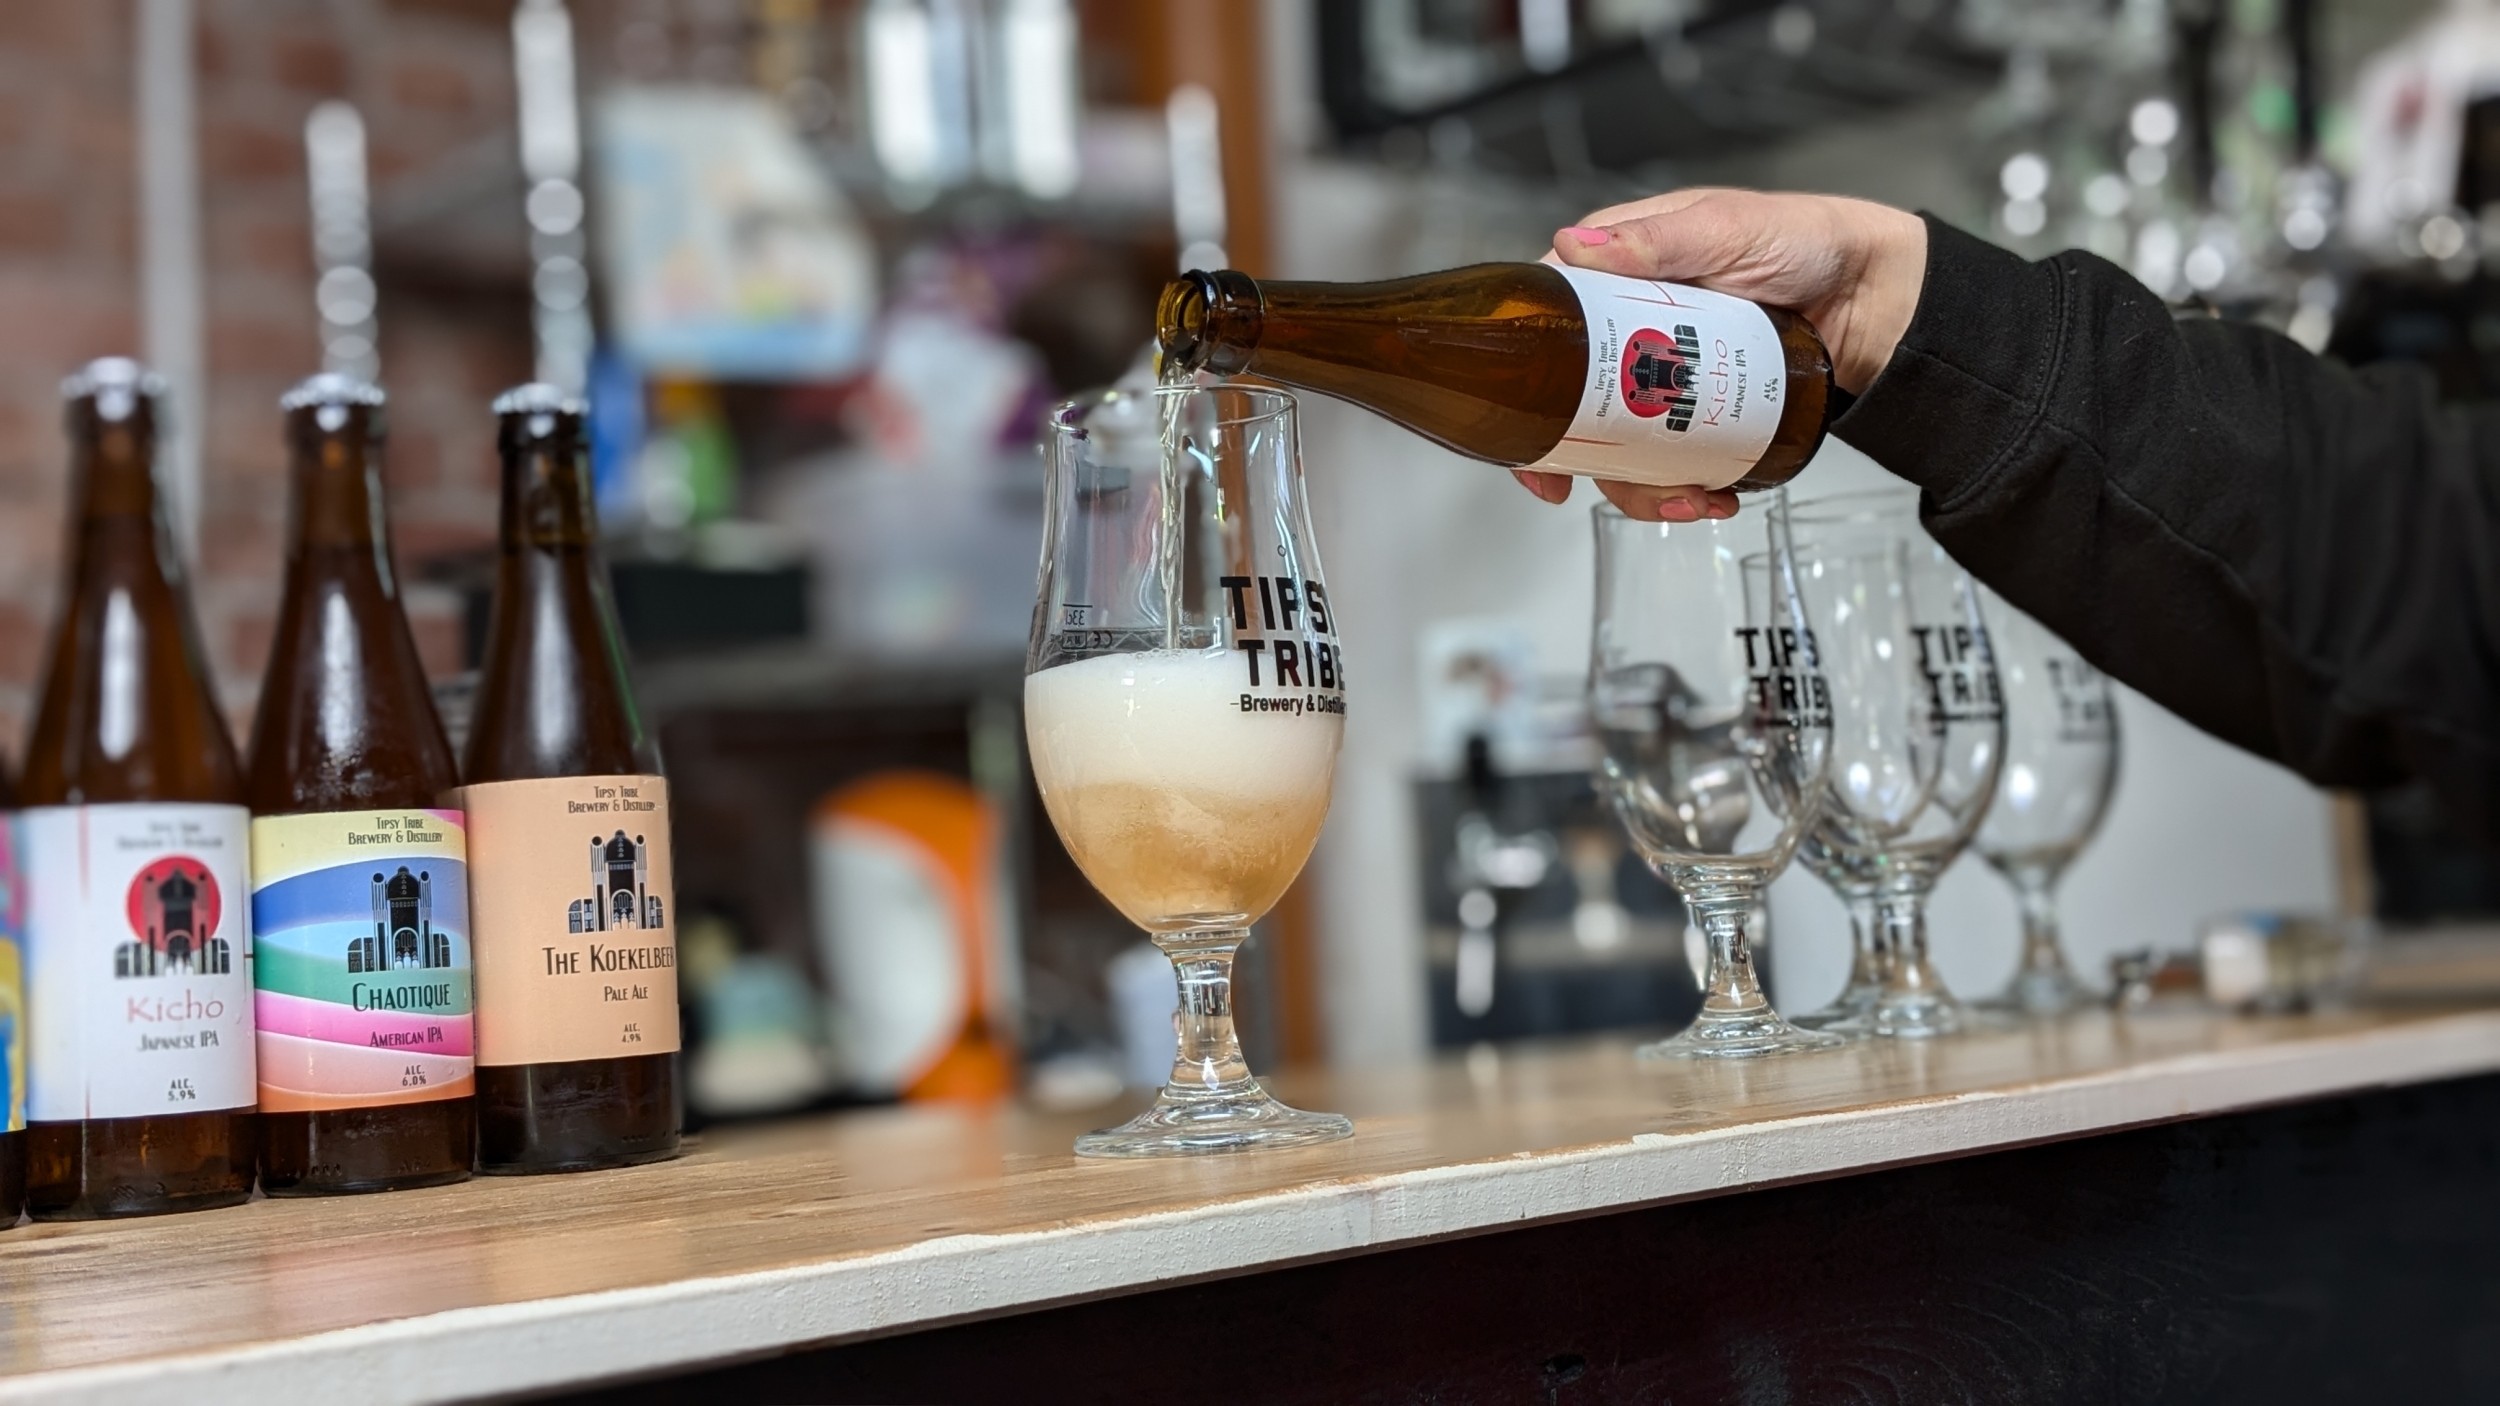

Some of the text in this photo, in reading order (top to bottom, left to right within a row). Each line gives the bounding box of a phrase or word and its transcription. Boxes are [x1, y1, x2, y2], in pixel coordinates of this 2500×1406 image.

[1596, 317, 1618, 418] BREWERY & DISTILLERY
[1595, 367, 1607, 391] TIPSY
[1703, 339, 1729, 426] Kicho
[1729, 349, 1747, 422] JAPANESE IPA
[1240, 694, 1304, 716] Brewery
[1306, 694, 1315, 711] &
[594, 785, 639, 798] TIPSY TRIBE
[568, 800, 609, 813] BREWERY
[613, 800, 620, 811] &
[376, 816, 424, 829] TIPSY TRIBE
[348, 830, 443, 845] BREWERY & DISTILLERY
[542, 947, 580, 976] THE
[352, 982, 451, 1012] CHAOTIQUE
[604, 984, 648, 1002] PALE ALE
[127, 988, 224, 1023] Kicho
[369, 1026, 443, 1048] AMERICAN IPA
[624, 1024, 640, 1033] ALC.
[200, 1030, 219, 1048] IPA
[405, 1065, 425, 1076] ALC.
[170, 1078, 193, 1090] ALC.
[402, 1077, 426, 1087] 6.0%
[168, 1089, 196, 1101] 5.9%
